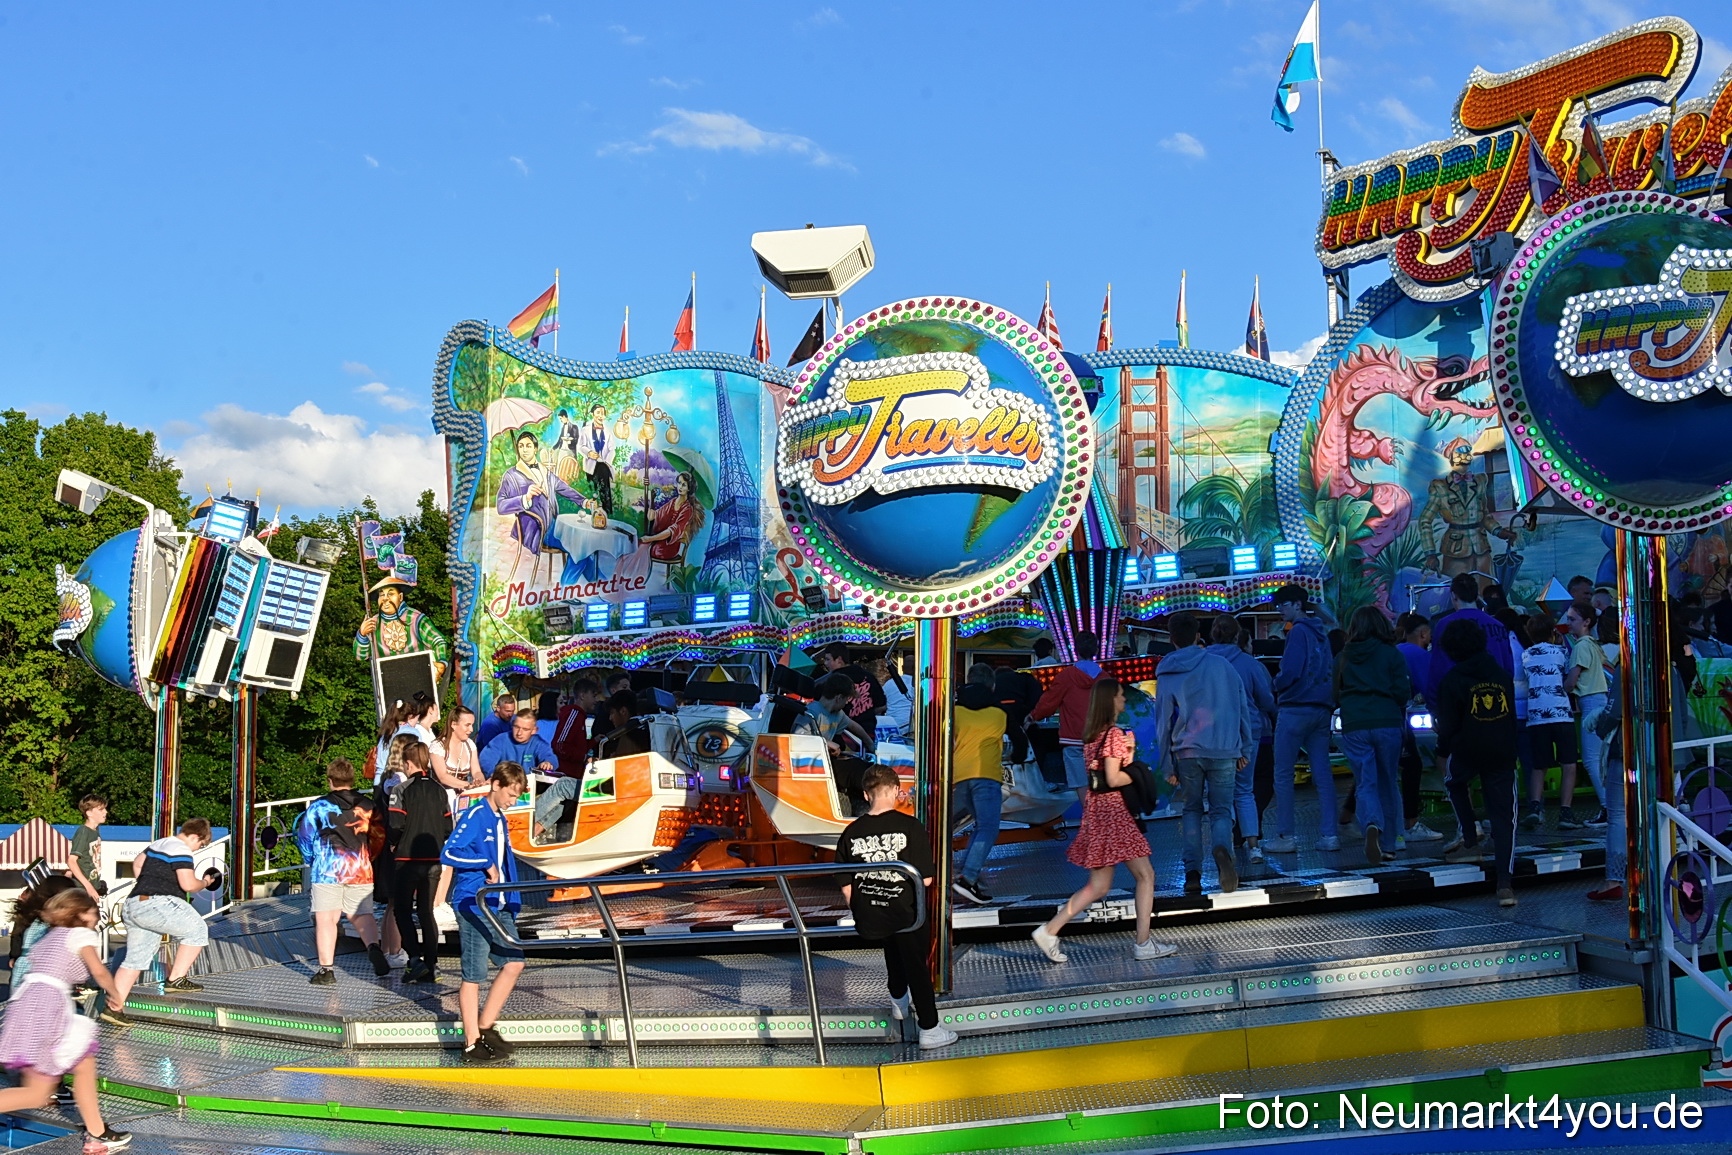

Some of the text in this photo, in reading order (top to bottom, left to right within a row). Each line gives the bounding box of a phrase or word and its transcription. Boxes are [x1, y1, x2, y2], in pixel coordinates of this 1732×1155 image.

[1323, 131, 1522, 250] HAPPY
[1576, 298, 1715, 361] HAPPY
[812, 370, 1043, 484] Traveller
[491, 574, 646, 618] Montmartre
[704, 737, 722, 750] 13
[850, 833, 907, 856] DRIP
